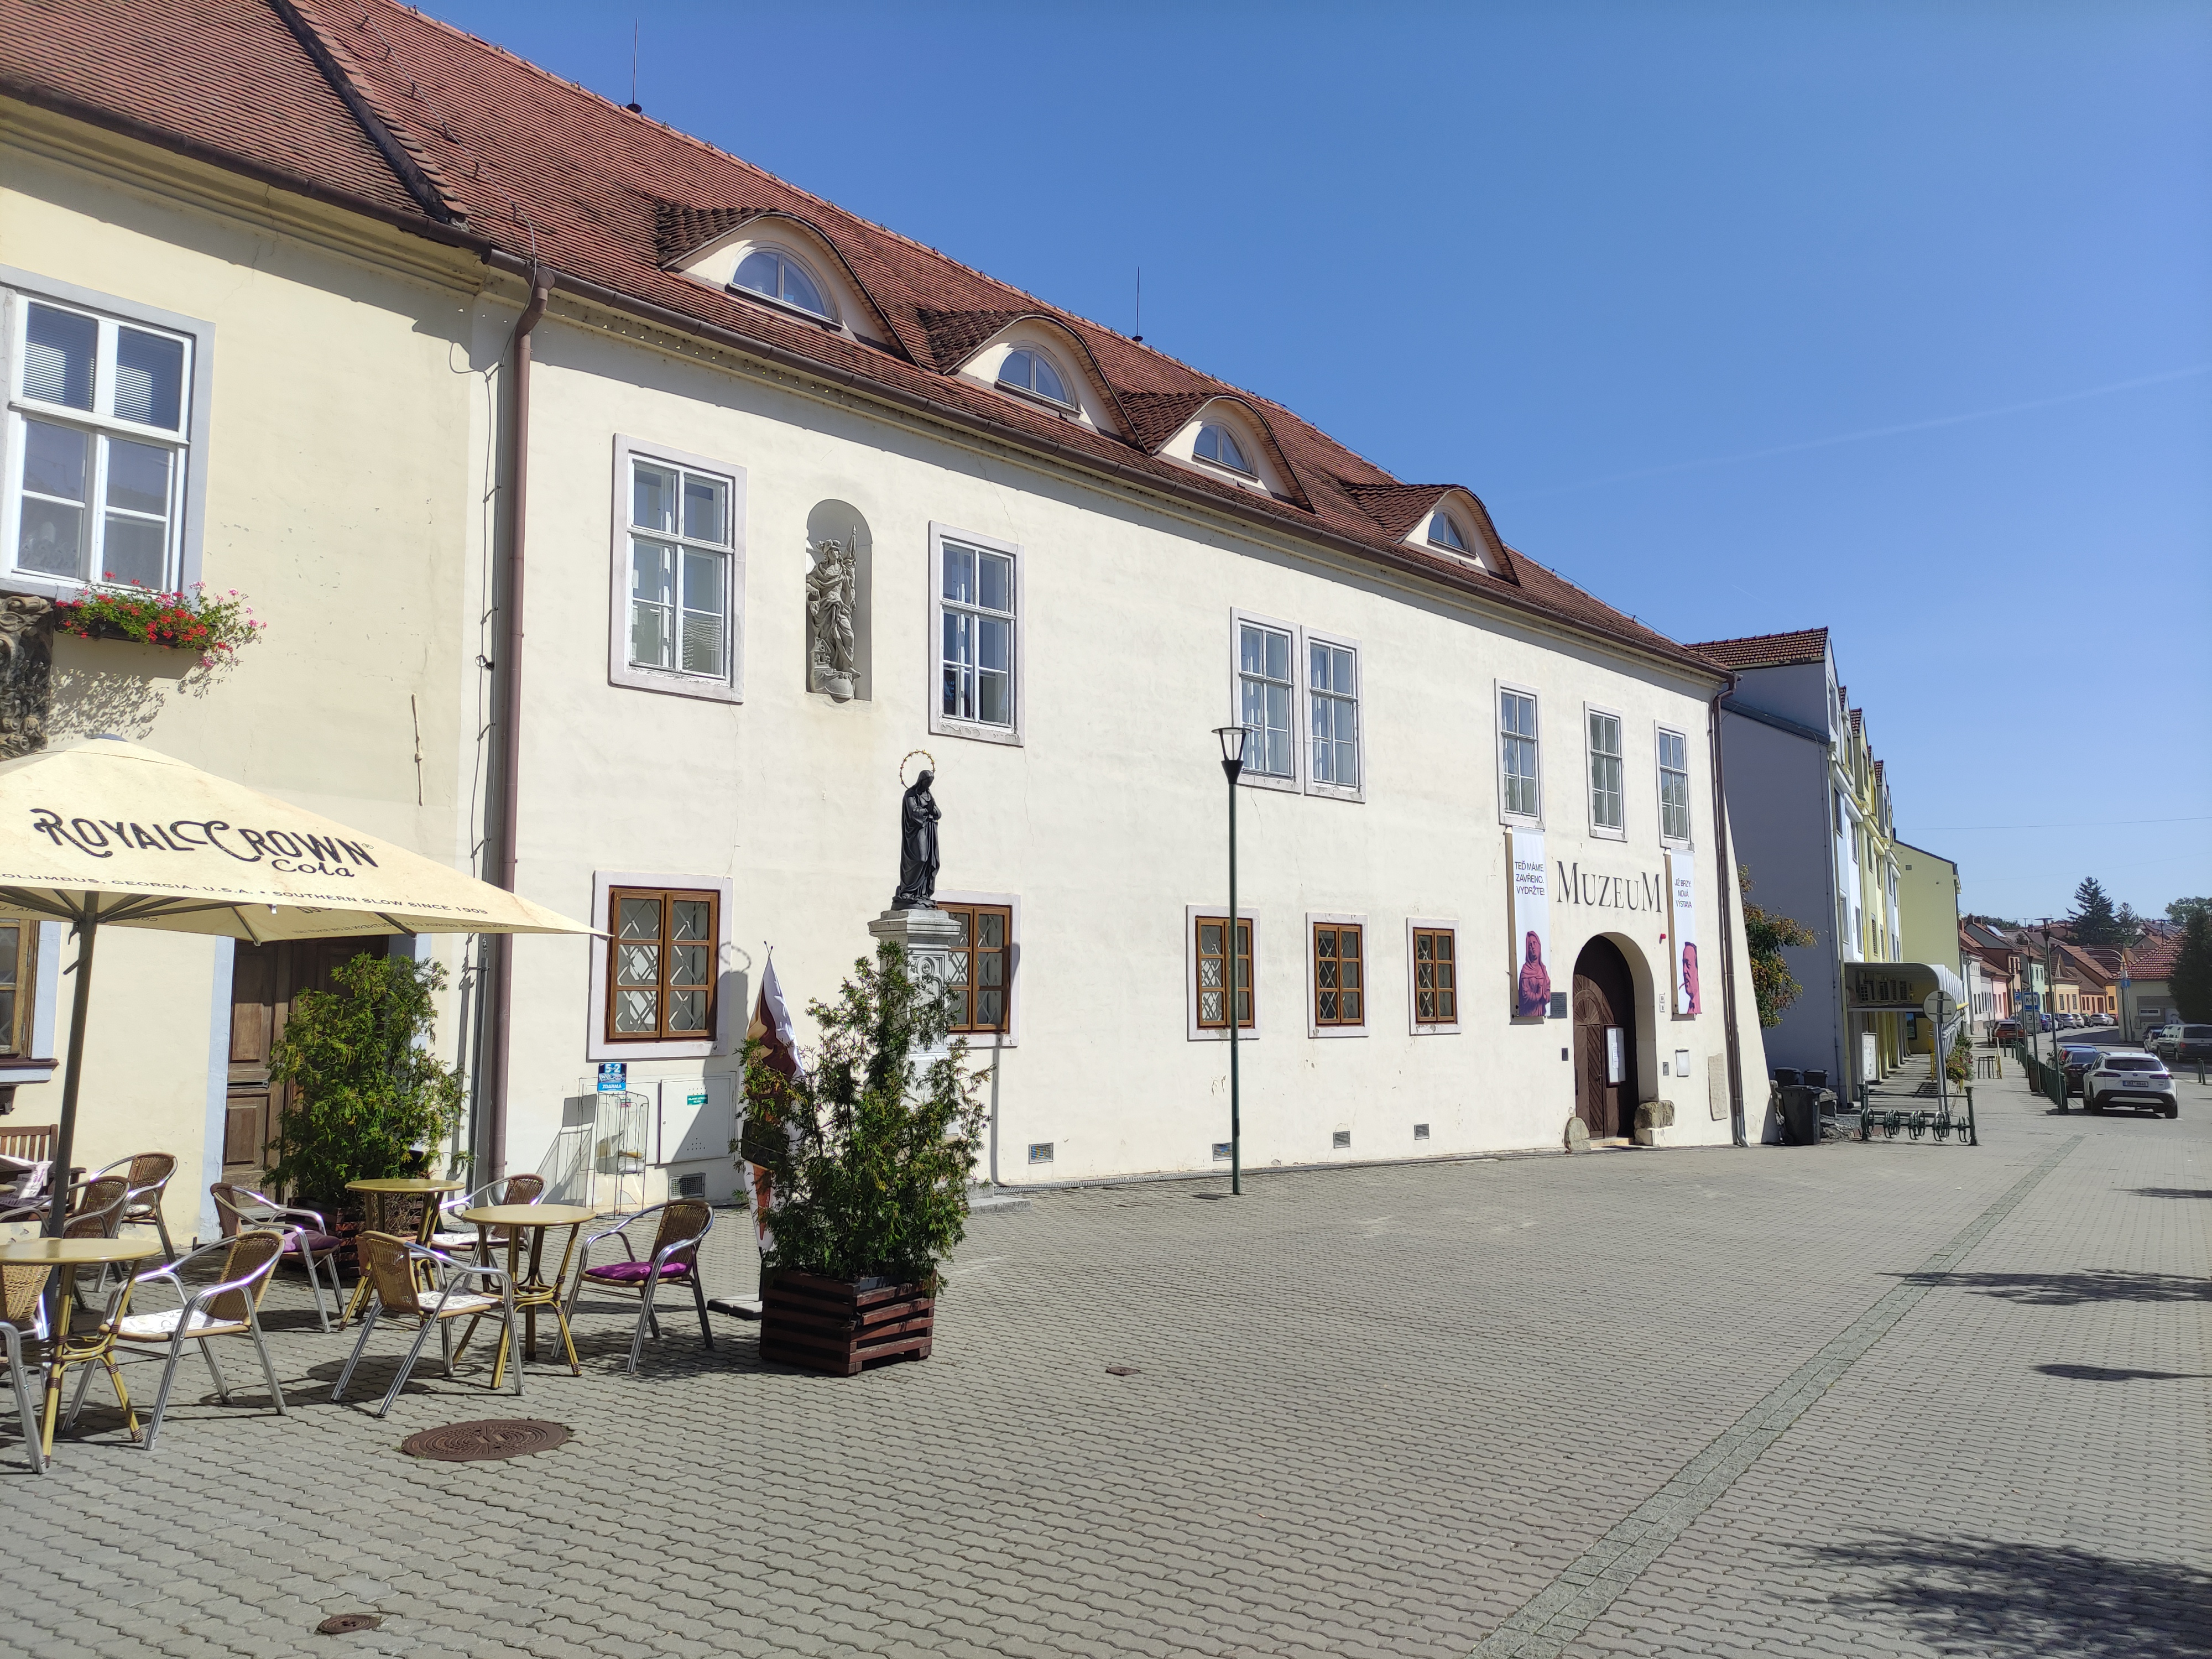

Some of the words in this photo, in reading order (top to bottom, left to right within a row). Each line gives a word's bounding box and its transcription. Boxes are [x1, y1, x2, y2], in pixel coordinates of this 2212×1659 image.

[30, 808, 195, 858] ROYAL
[170, 821, 379, 868] CROWN
[272, 859, 355, 877] Cola
[1515, 860, 1526, 870] TEĎ
[1527, 862, 1544, 872] MÁME
[1516, 873, 1544, 884] ZAVŘENO.
[1516, 885, 1545, 895] VYDRŽTE!
[1557, 860, 1662, 913] MUZEUM
[0, 874, 106, 884] OLUMBUS,
[112, 880, 197, 891] GEORGIA,
[202, 886, 253, 895] U.S.A.
[273, 891, 357, 902] SOUTHERN
[408, 902, 451, 911] SINCE
[455, 906, 488, 915] 1905
[1678, 889, 1689, 898] NOVÁ
[1676, 899, 1692, 908] VÝSTAVA
